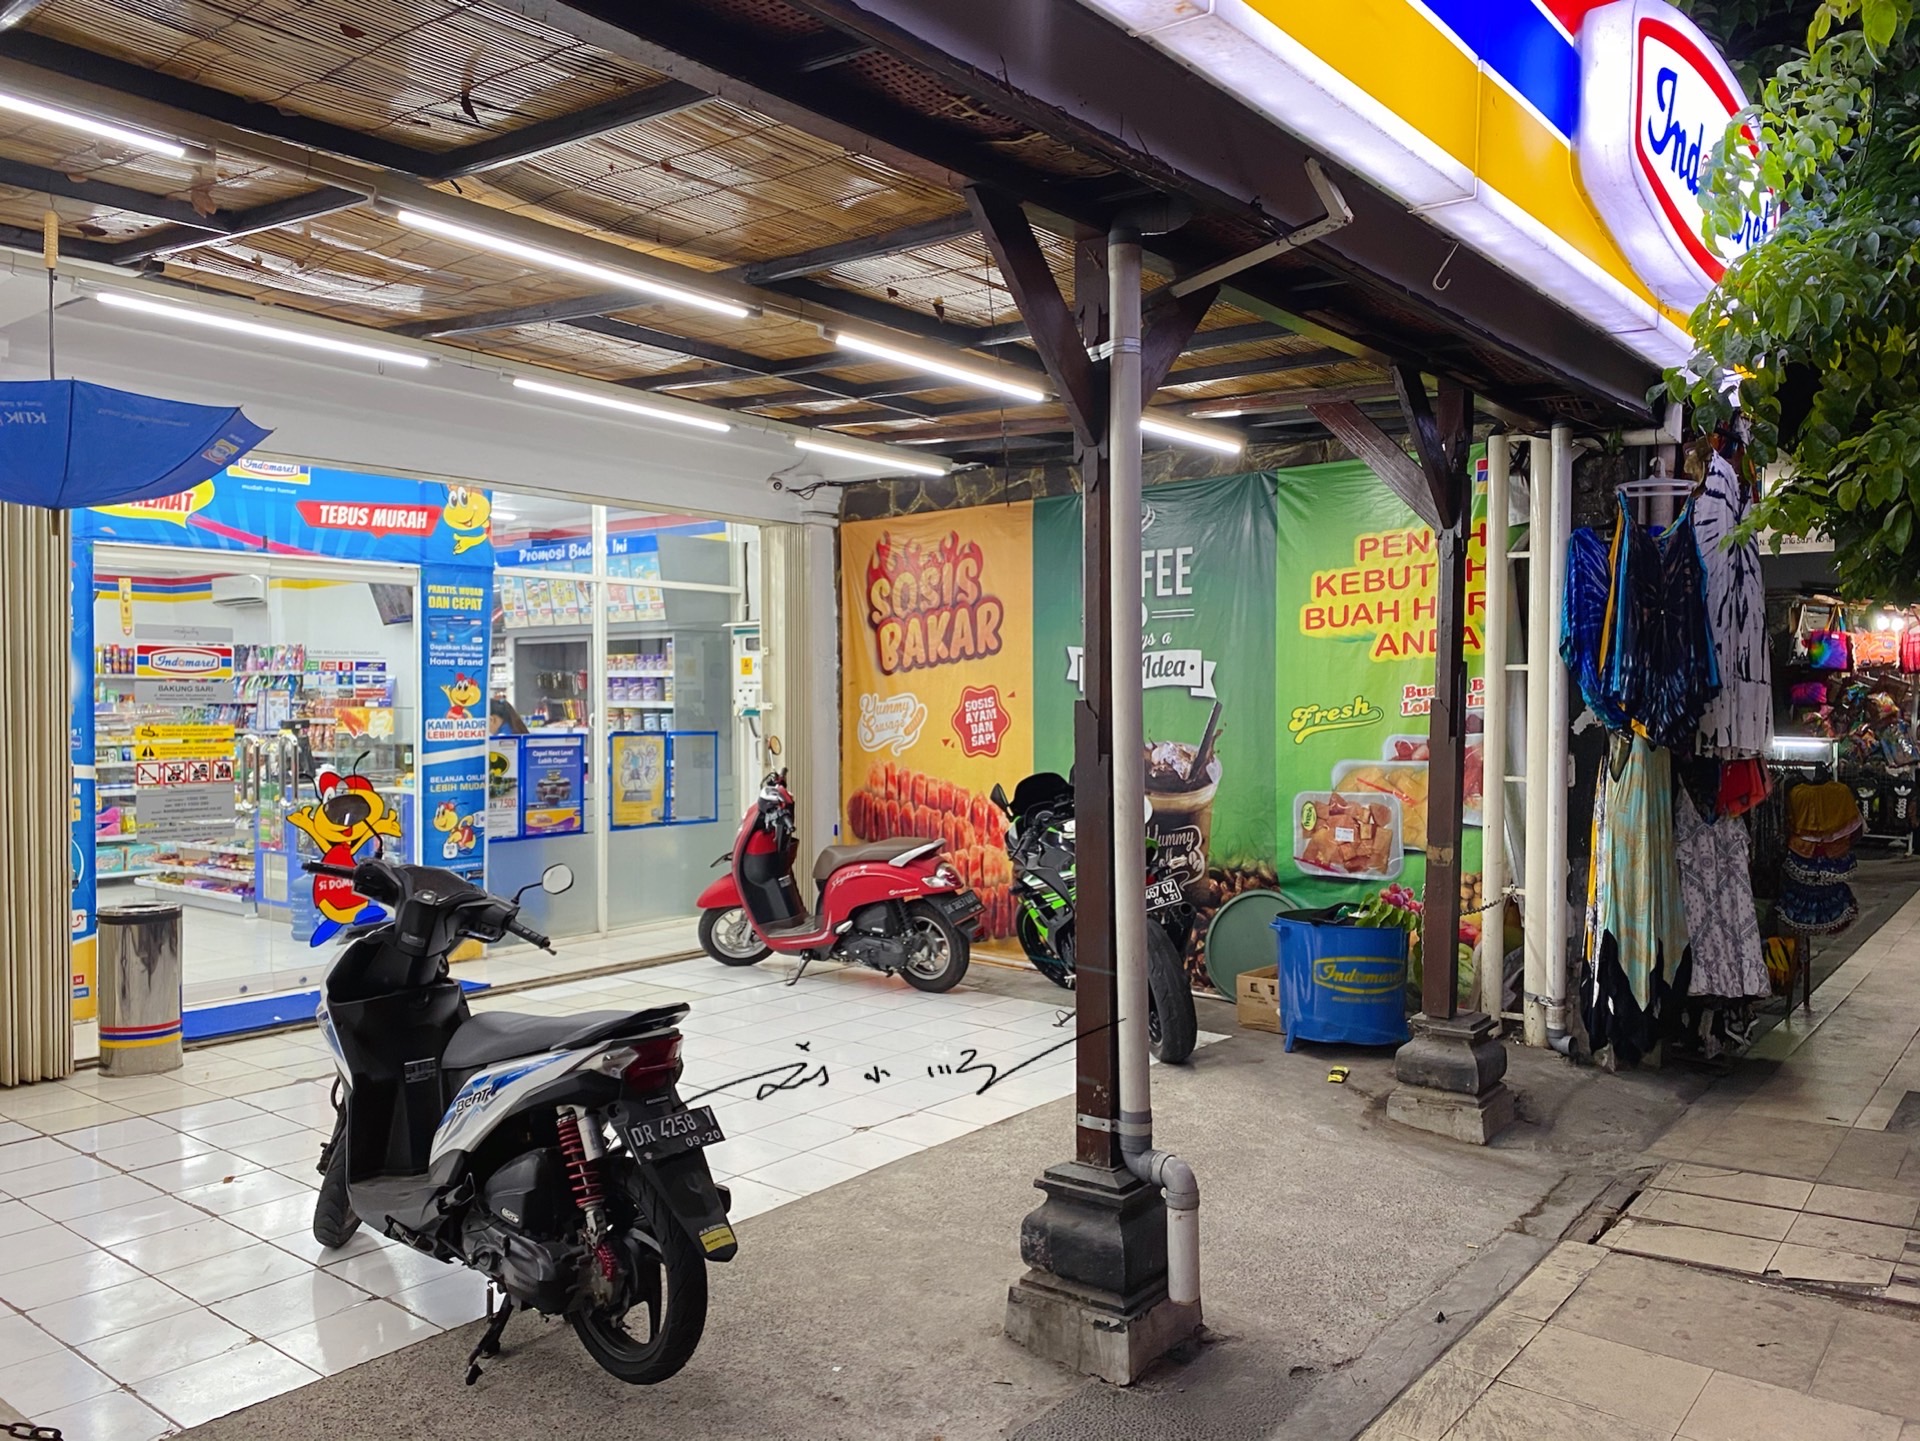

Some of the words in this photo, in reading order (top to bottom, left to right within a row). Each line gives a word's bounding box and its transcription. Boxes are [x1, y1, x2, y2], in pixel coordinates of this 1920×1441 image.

[243, 458, 296, 473] Indomaret
[242, 484, 263, 492] mudah
[319, 504, 369, 525] TEBUS
[371, 508, 428, 529] MURAH
[519, 545, 565, 562] Promosi
[612, 538, 628, 553] Ini
[870, 556, 980, 624] SOSIS
[428, 596, 450, 609] DAN
[452, 597, 483, 611] CEPAT
[1304, 599, 1400, 630] BUAH
[879, 600, 1000, 673] BAKAR
[155, 655, 216, 668] Indomaret
[429, 657, 455, 666] Home
[457, 658, 484, 666] Brand
[1143, 654, 1186, 678] Idea
[194, 684, 213, 692] SARI
[860, 694, 910, 715] Yummy
[965, 696, 994, 712] SOSIS
[965, 710, 997, 724] AYAM
[1288, 694, 1371, 732] Fresh
[427, 719, 453, 730] KAMI
[456, 718, 486, 729] HADIR
[971, 721, 994, 736] DAN
[427, 730, 455, 739] LEBIH
[457, 729, 486, 739] DEKAT
[971, 732, 997, 747] SAPI
[430, 774, 464, 784] BELANJA
[429, 783, 457, 793] LEBIH
[319, 880, 327, 891] Si
[630, 1124, 657, 1147] DR
[660, 1113, 697, 1138] 4258
[701, 1106, 715, 1127] Y
